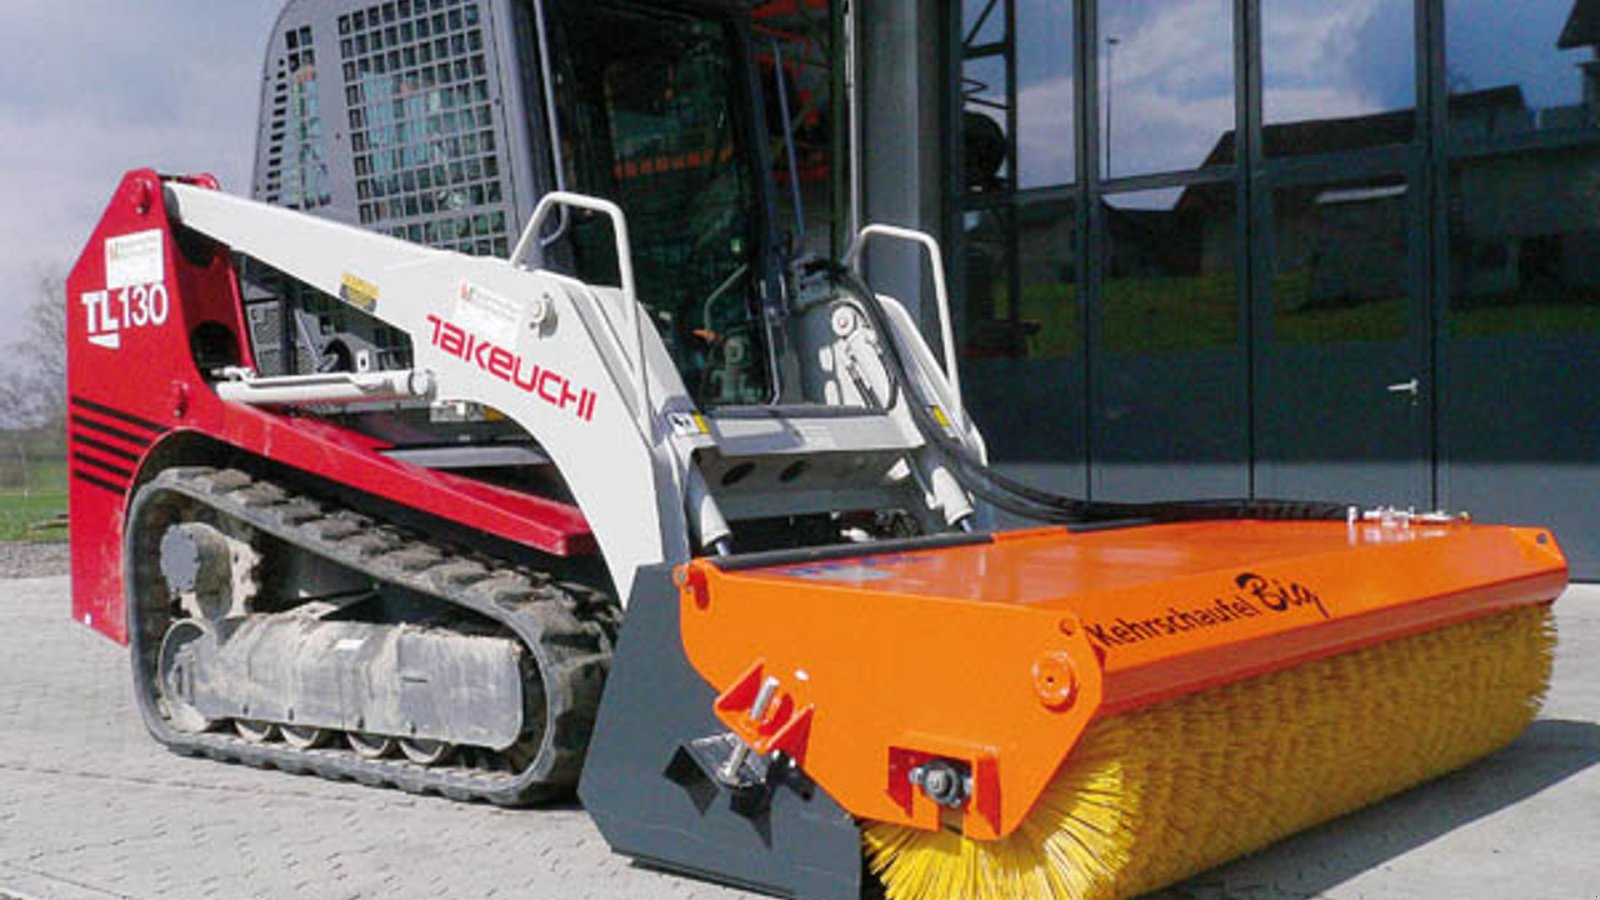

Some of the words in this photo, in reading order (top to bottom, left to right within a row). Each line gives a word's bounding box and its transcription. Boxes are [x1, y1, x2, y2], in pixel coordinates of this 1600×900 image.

[81, 284, 169, 334] TL130
[1086, 596, 1261, 648] Kehrschaufel
[1235, 573, 1330, 619] Big
